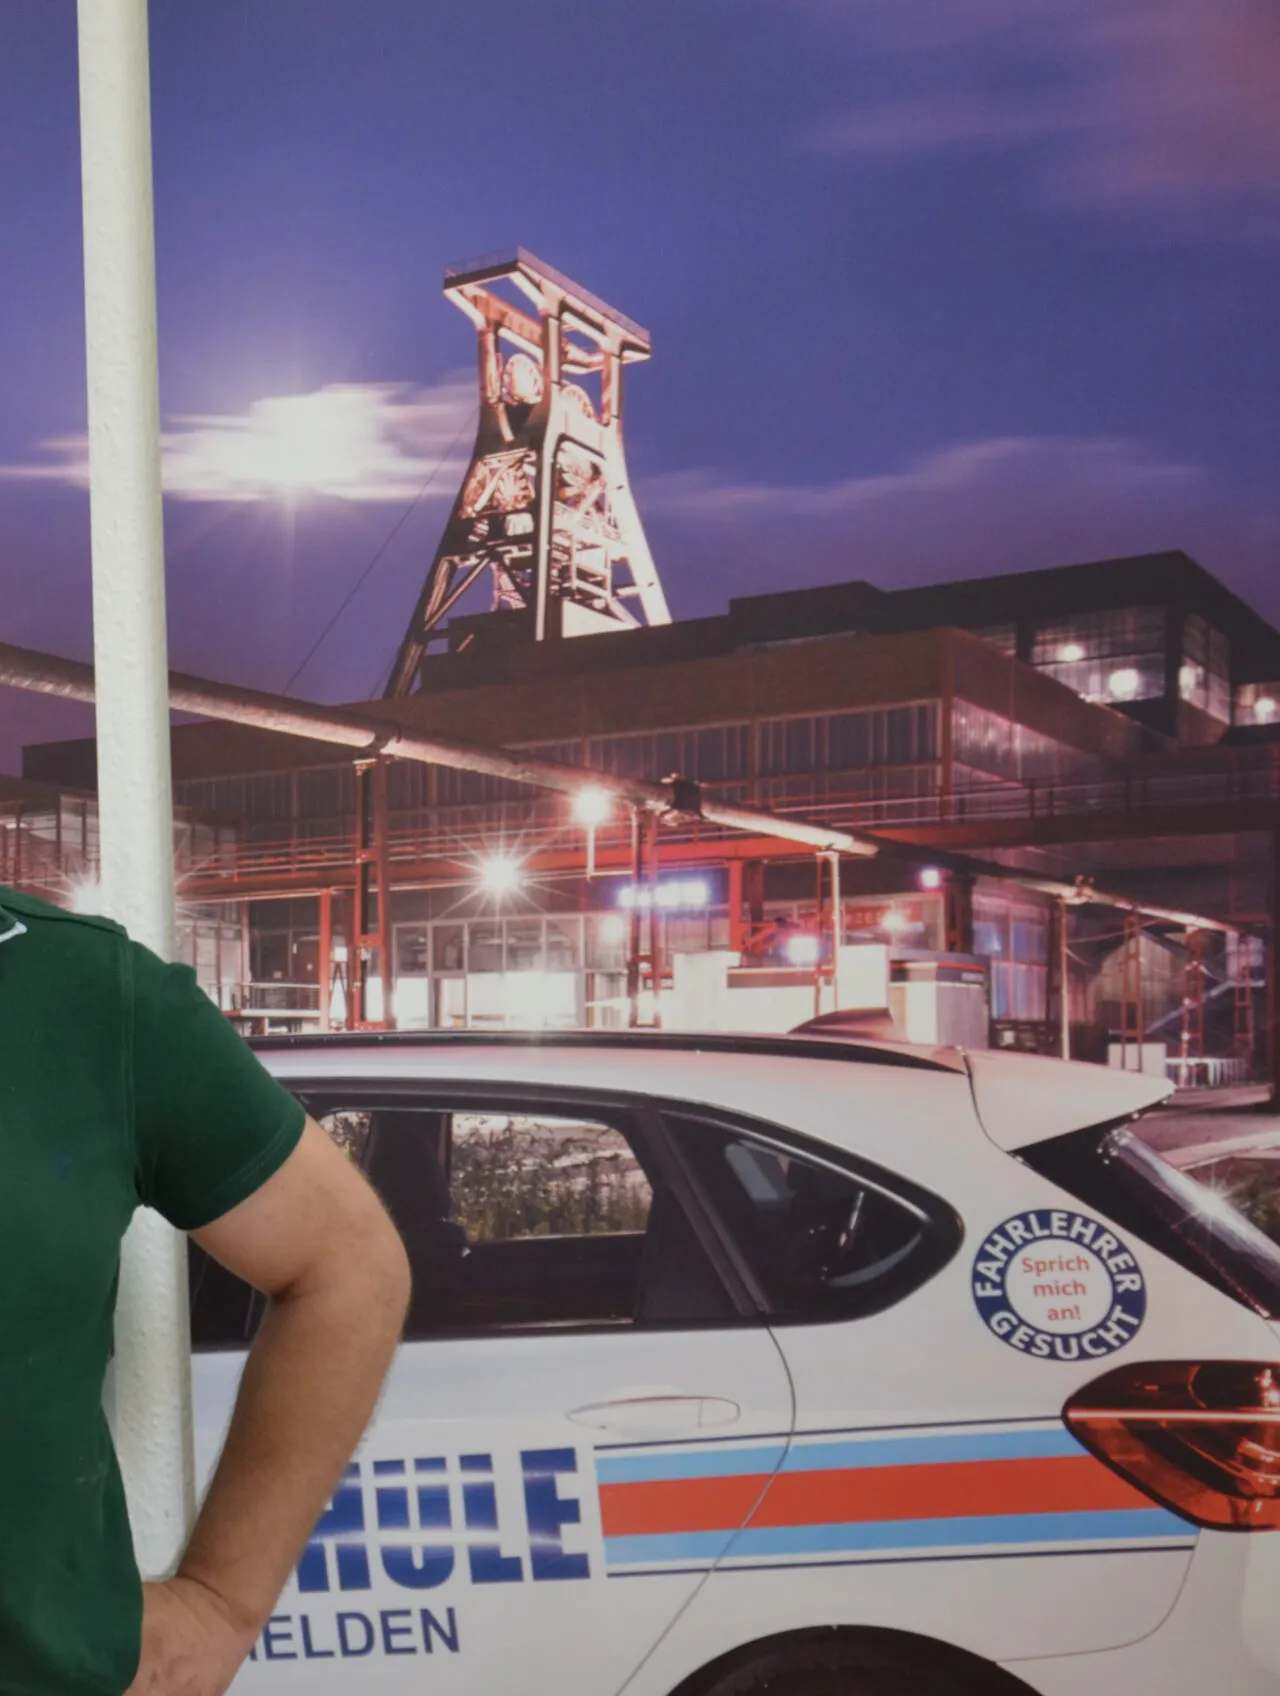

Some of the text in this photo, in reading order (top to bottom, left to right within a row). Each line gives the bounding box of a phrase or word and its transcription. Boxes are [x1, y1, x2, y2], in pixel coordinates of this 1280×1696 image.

[974, 1211, 1142, 1298] FAHRLEHRER
[1022, 1256, 1090, 1277] Sprich
[1033, 1280, 1087, 1297] mich
[1047, 1305, 1081, 1321] an!
[989, 1305, 1140, 1360] GESUCHT
[248, 1607, 461, 1662] ELDEN
